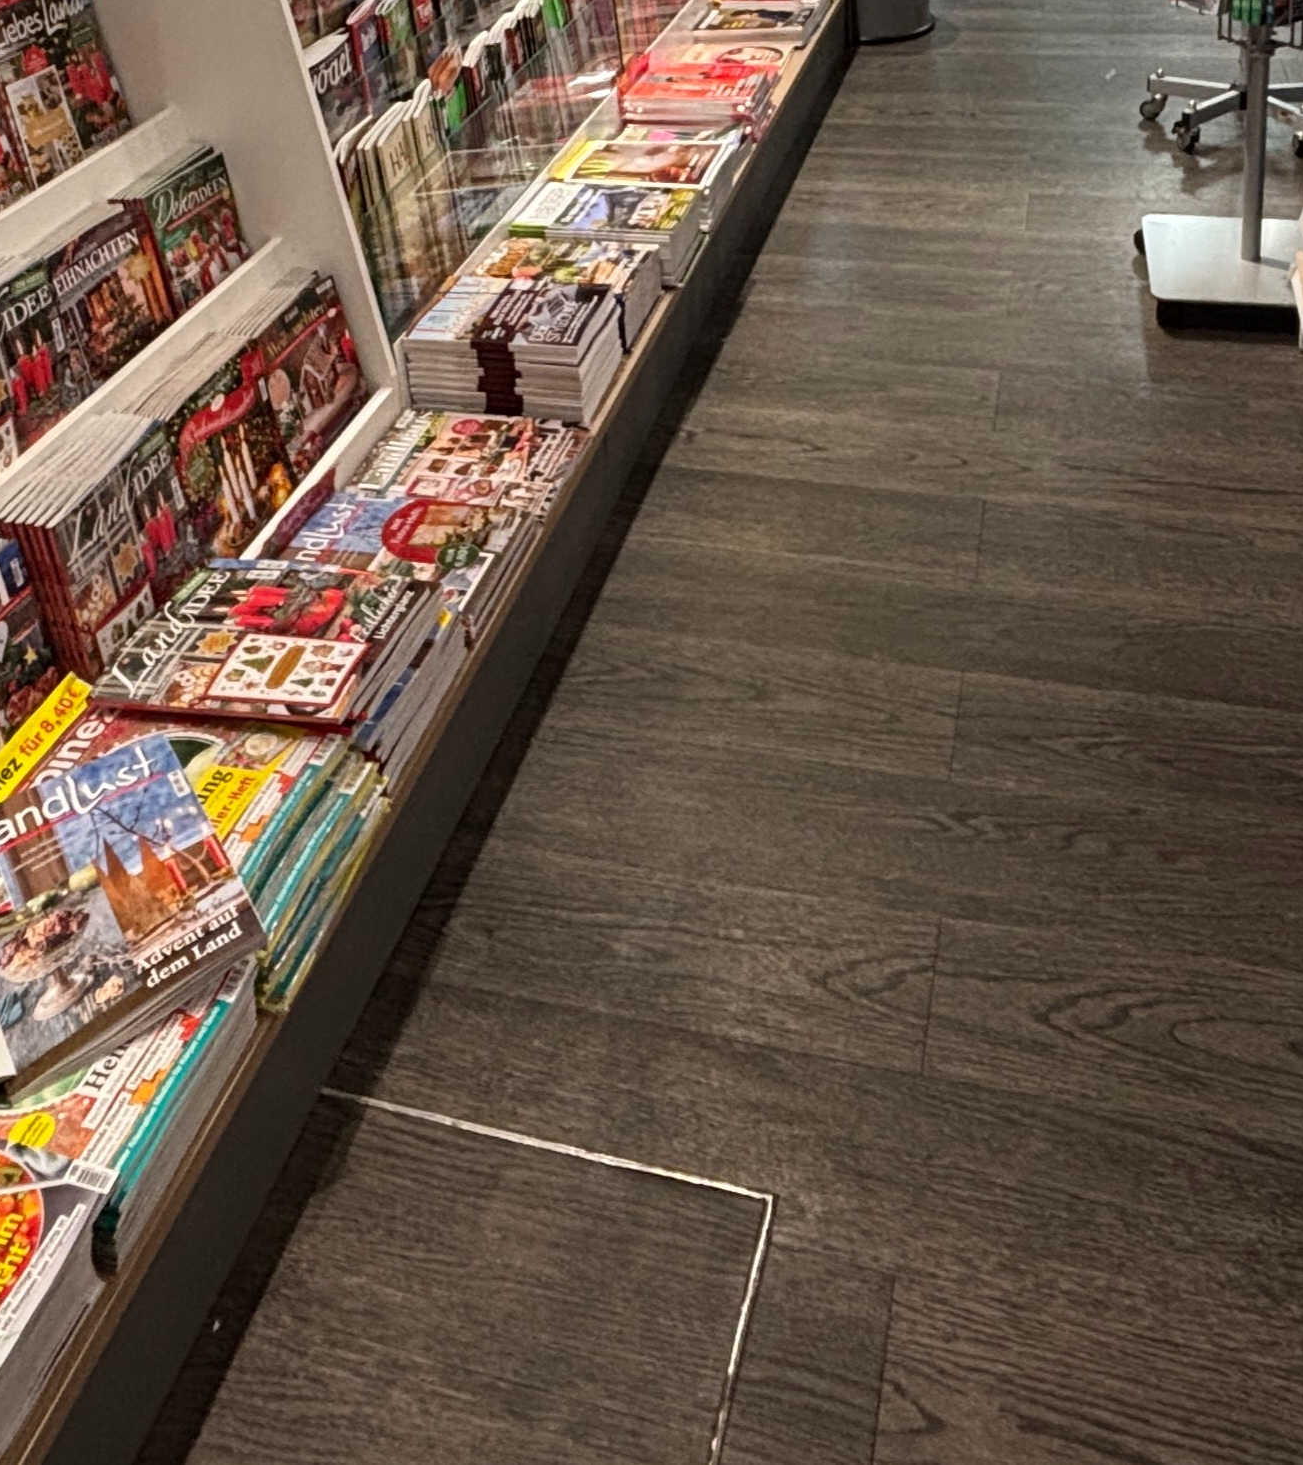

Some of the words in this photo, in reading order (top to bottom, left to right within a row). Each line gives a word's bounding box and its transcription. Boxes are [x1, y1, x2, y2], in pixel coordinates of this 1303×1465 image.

[132, 920, 206, 976] Advent
[205, 903, 241, 935] auf
[144, 955, 191, 991] dem
[189, 923, 244, 966] Land
